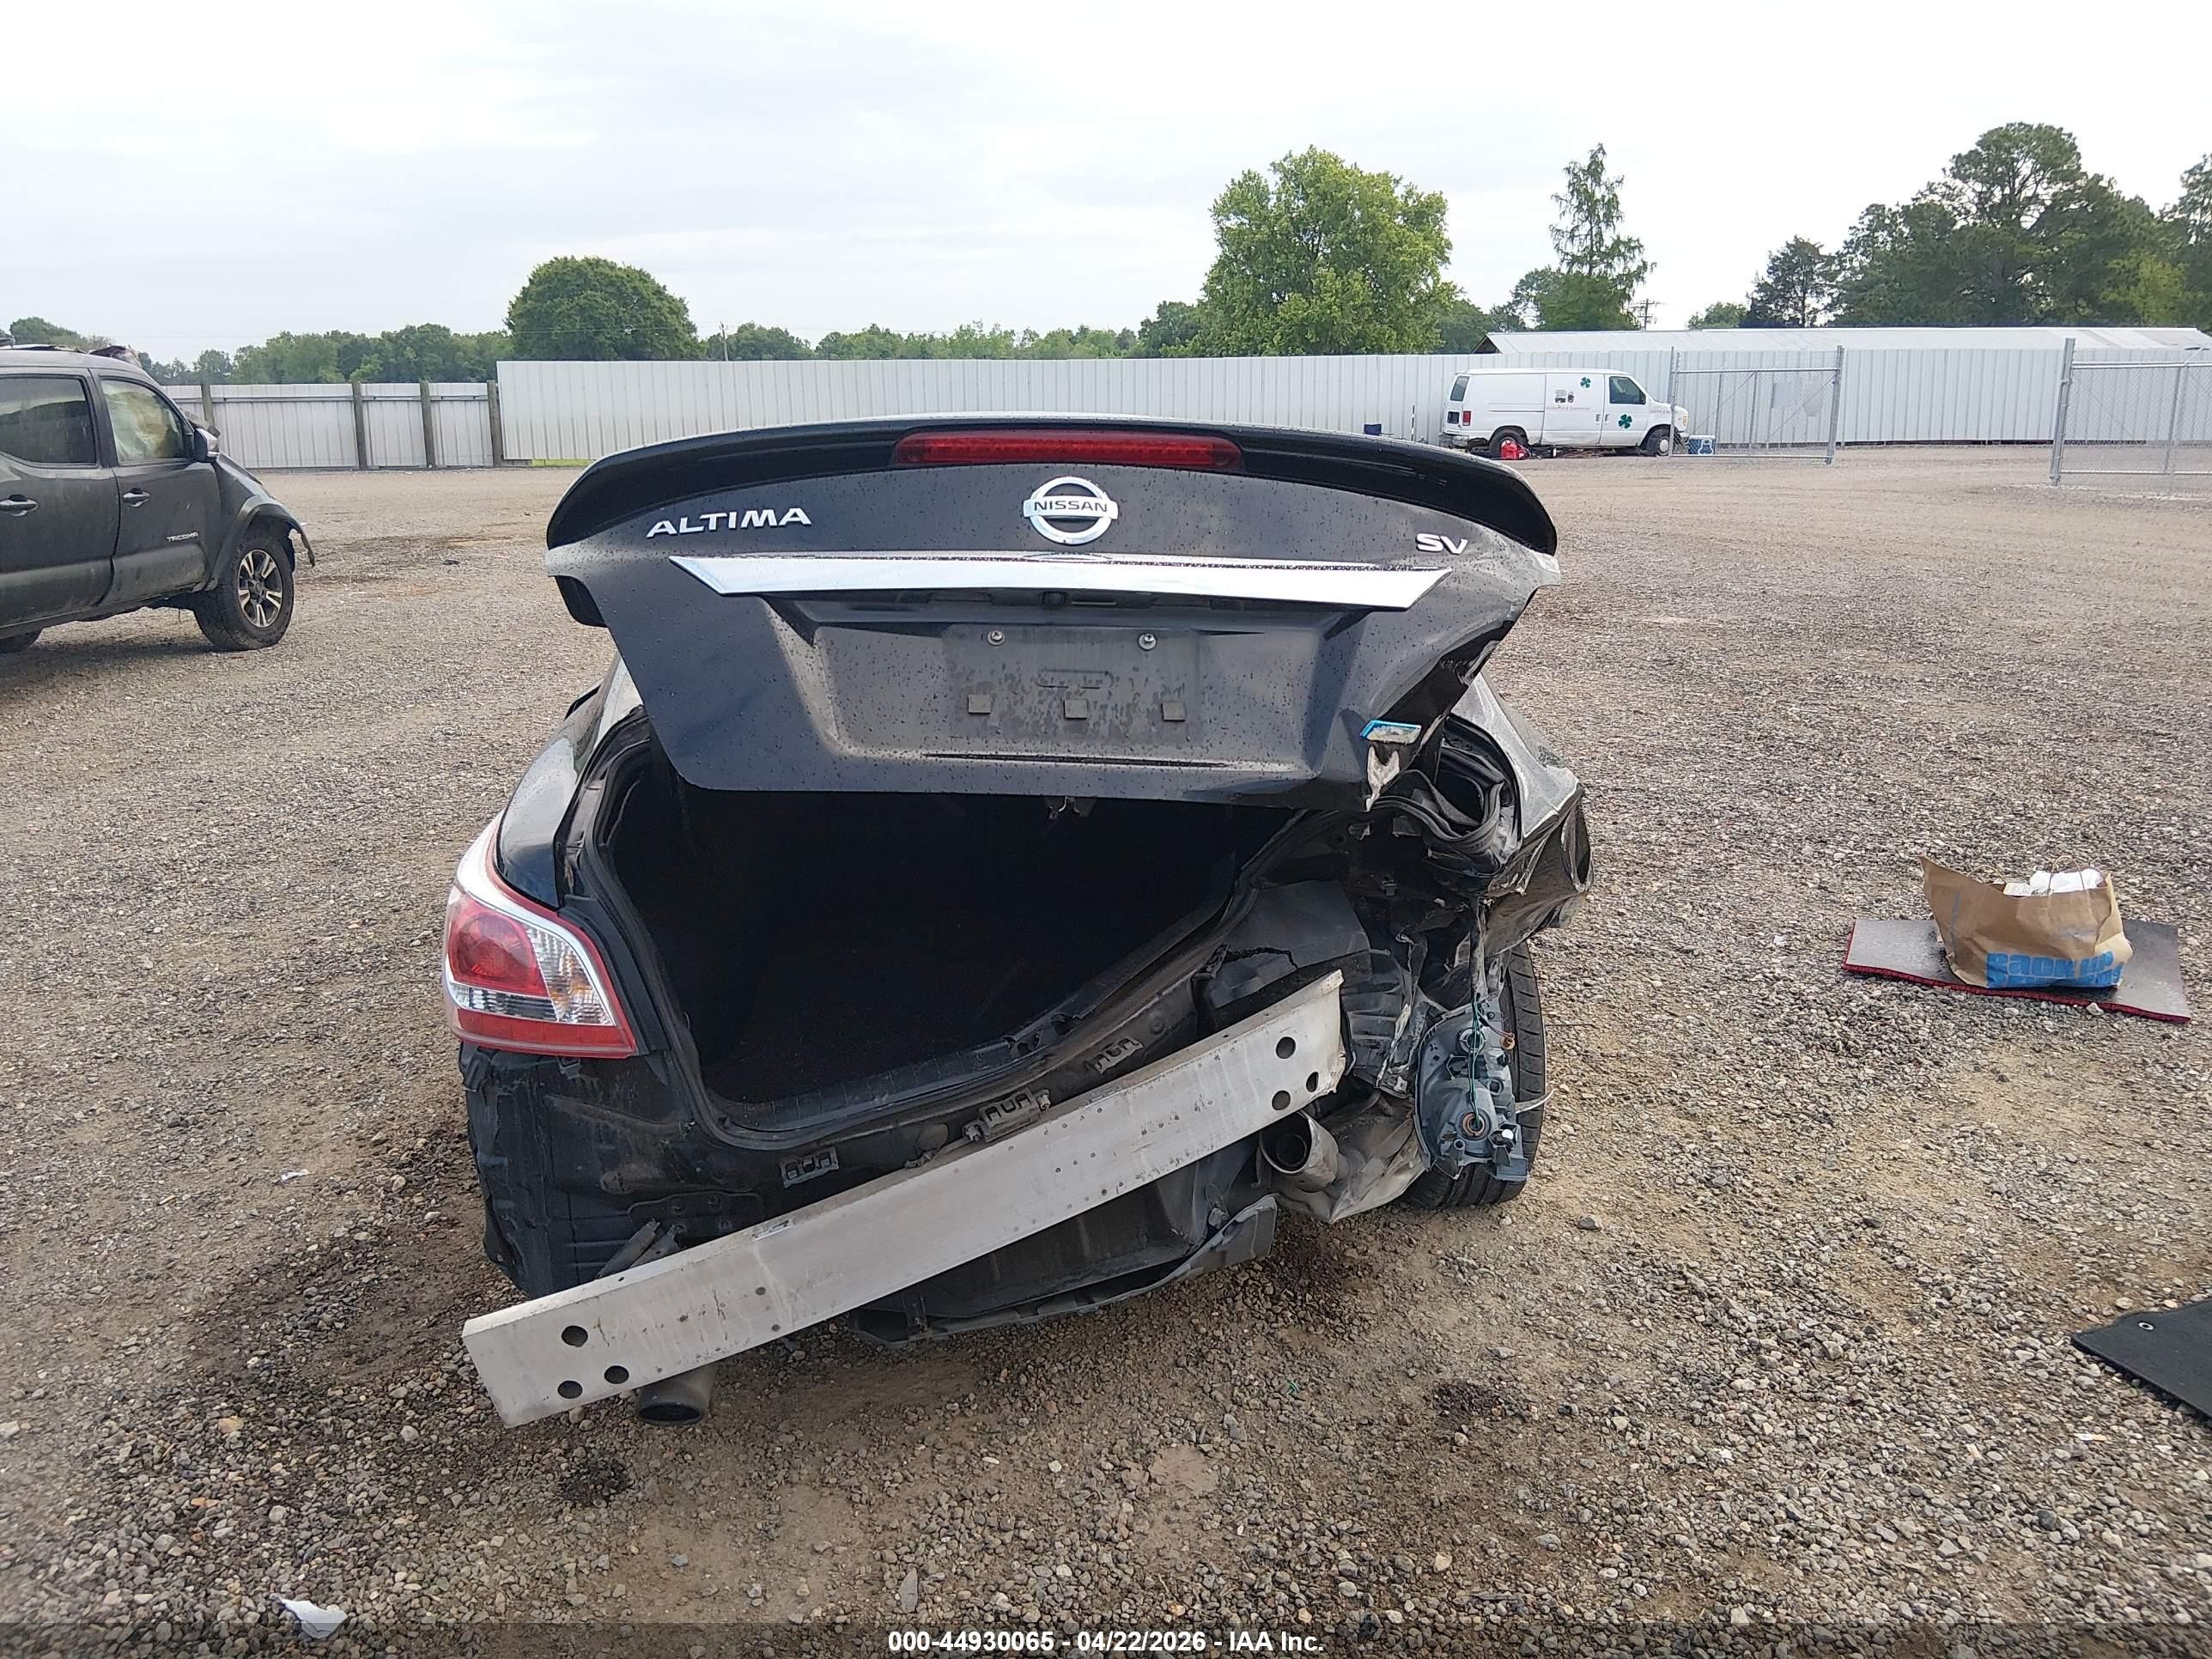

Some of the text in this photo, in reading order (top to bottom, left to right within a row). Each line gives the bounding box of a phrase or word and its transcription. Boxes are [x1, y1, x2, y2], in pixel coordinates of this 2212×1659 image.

[1034, 500, 1108, 513] NISSAN
[645, 507, 812, 538] ALTIMA
[1416, 532, 1468, 555] SV
